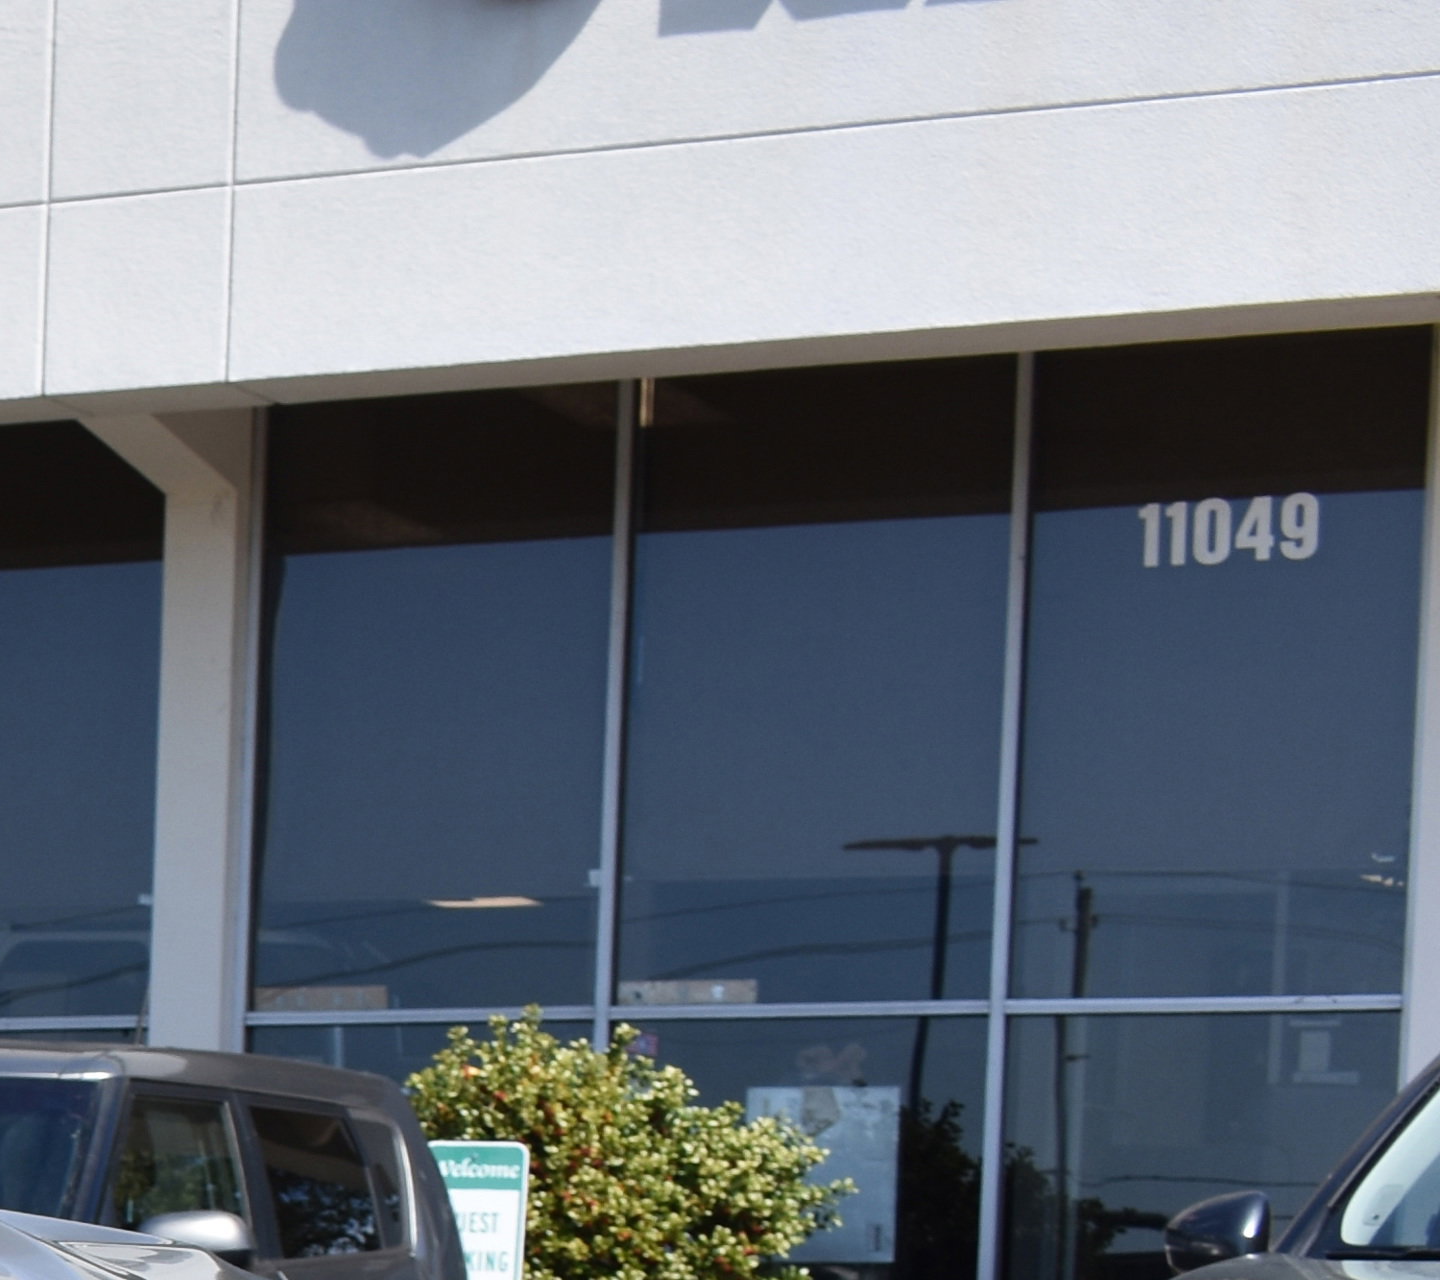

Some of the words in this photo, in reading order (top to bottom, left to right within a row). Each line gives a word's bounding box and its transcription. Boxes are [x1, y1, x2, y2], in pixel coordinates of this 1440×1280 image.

[1138, 492, 1320, 568] 11049
[438, 1157, 520, 1179] Welcome
[455, 1212, 498, 1233] UEST
[464, 1251, 509, 1272] KING
